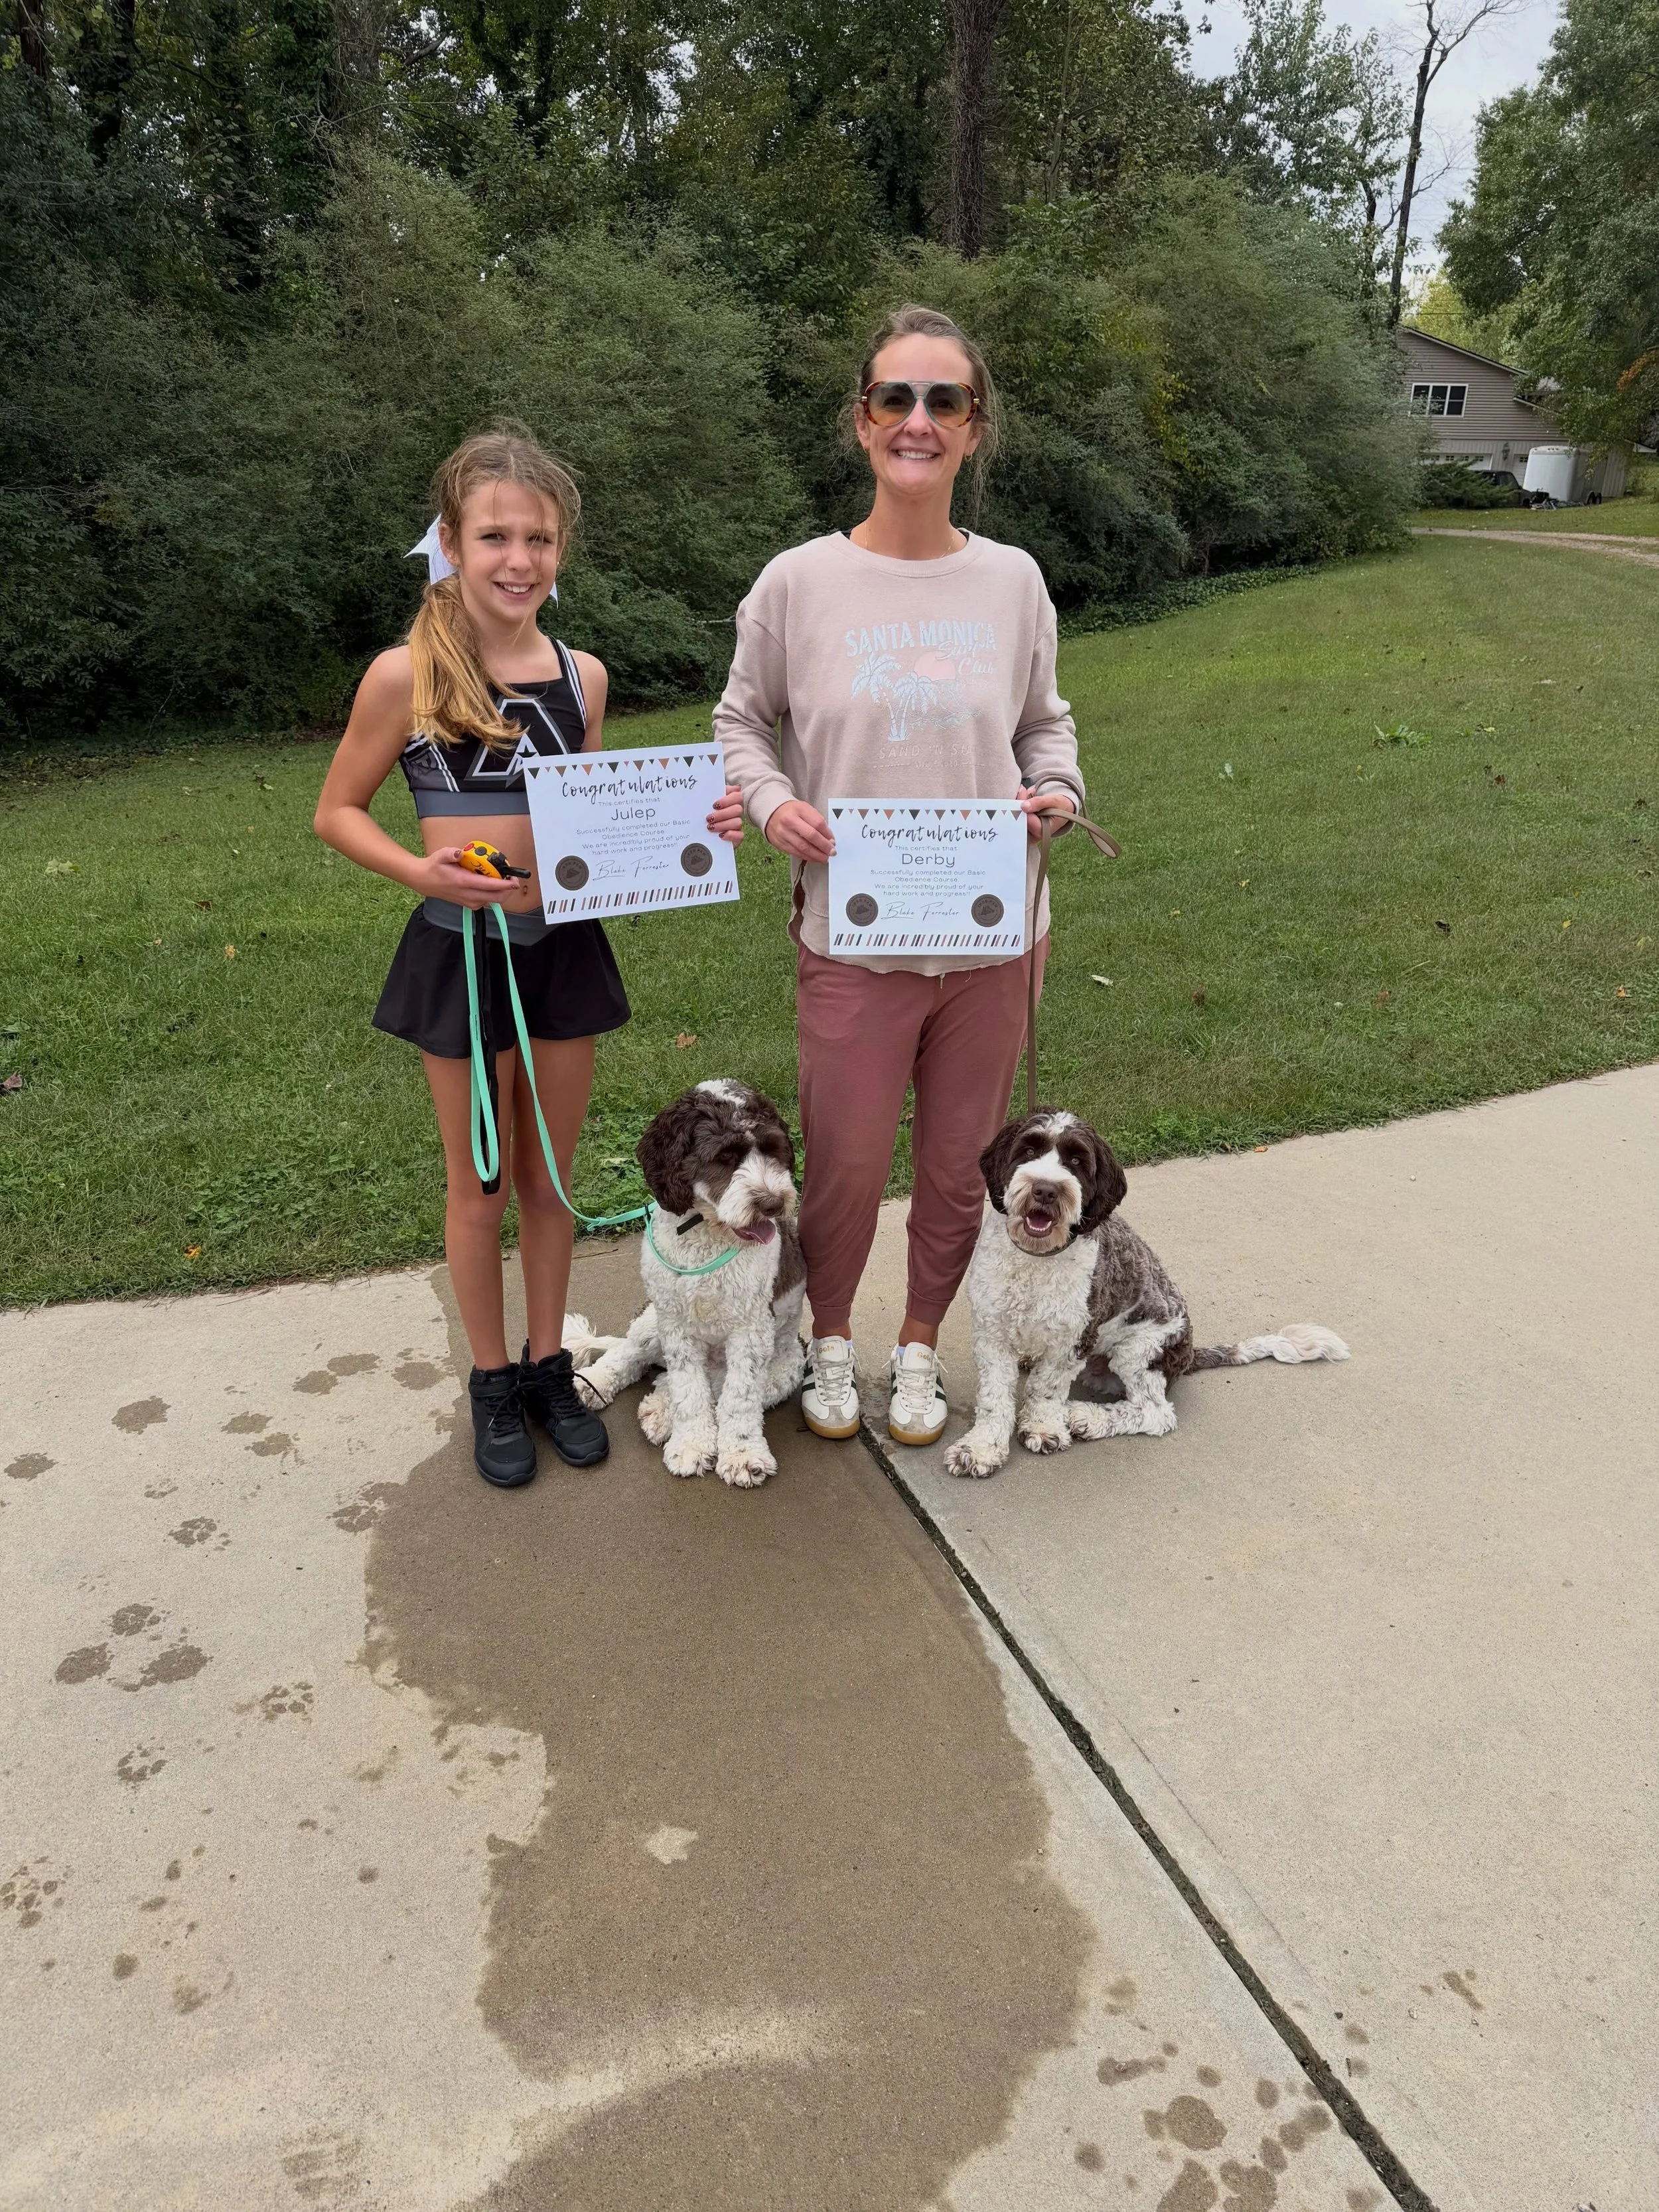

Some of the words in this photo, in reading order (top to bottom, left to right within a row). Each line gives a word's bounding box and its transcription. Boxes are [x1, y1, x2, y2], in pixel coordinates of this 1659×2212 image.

[845, 622, 914, 657] SANTA
[918, 619, 997, 650] MONICA
[958, 658, 994, 676] Club
[879, 745, 920, 759] SAND
[562, 774, 697, 805] Congratulations
[611, 808, 656, 820] Julep
[577, 826, 620, 835] Successfully
[861, 824, 999, 848] Congratulations
[902, 853, 955, 867] Derby
